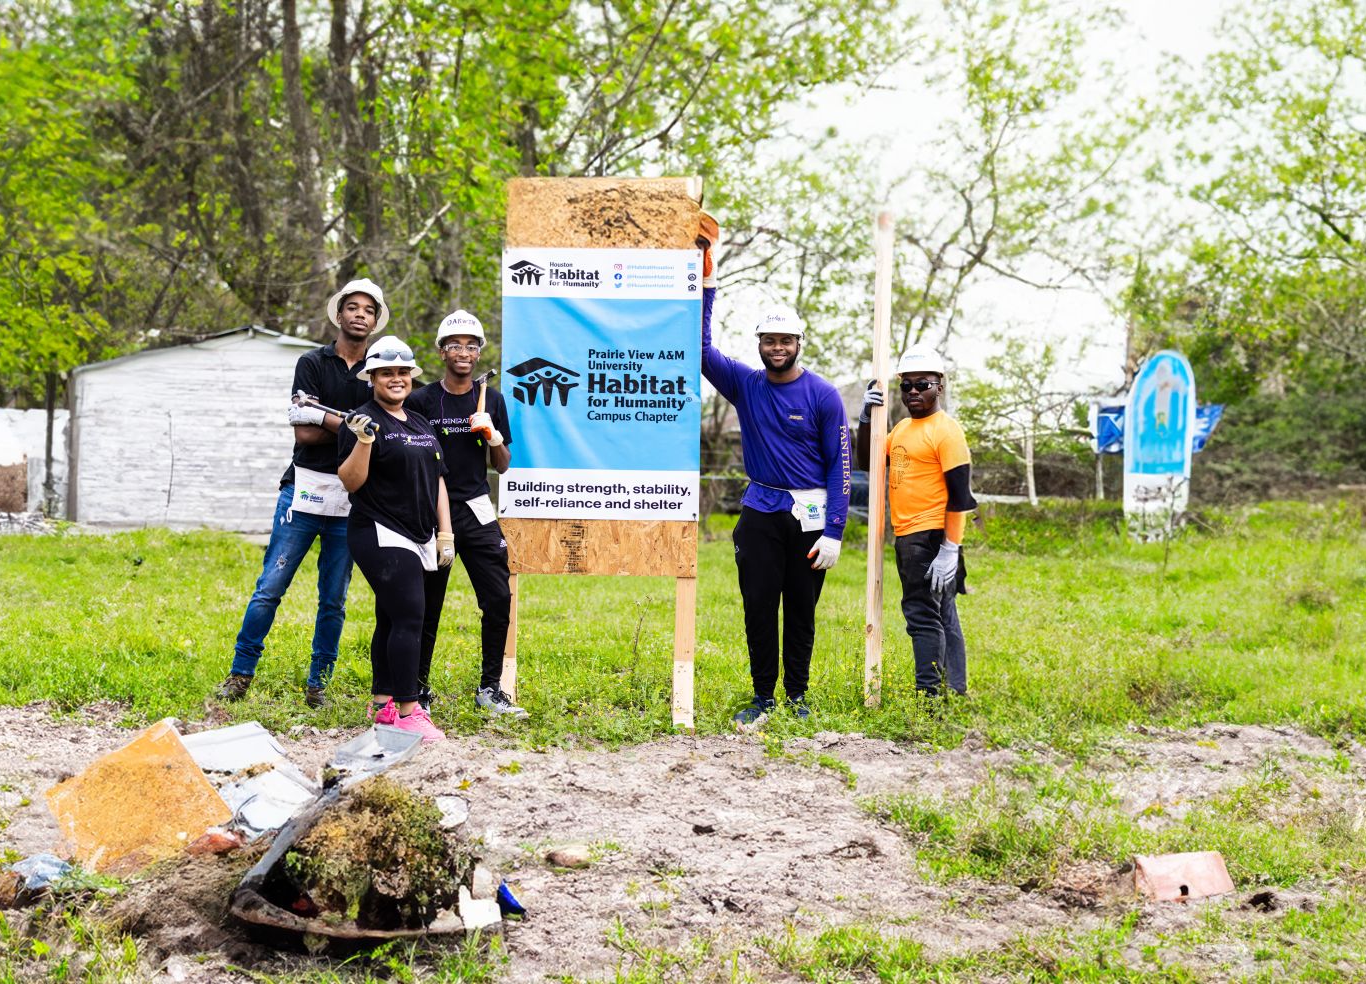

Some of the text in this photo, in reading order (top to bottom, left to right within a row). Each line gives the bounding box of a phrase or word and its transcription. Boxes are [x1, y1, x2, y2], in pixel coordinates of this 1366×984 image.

[549, 269, 600, 281] Habitat
[588, 349, 685, 360] Prairie View A&M
[588, 361, 643, 373] University
[587, 372, 687, 395] Habitat
[587, 396, 608, 408] for
[587, 411, 678, 424] Campus Chapter
[839, 425, 850, 495] PANTHERS
[507, 481, 691, 496] Building strength, stability,
[514, 497, 683, 510] self-reliance and shelter
